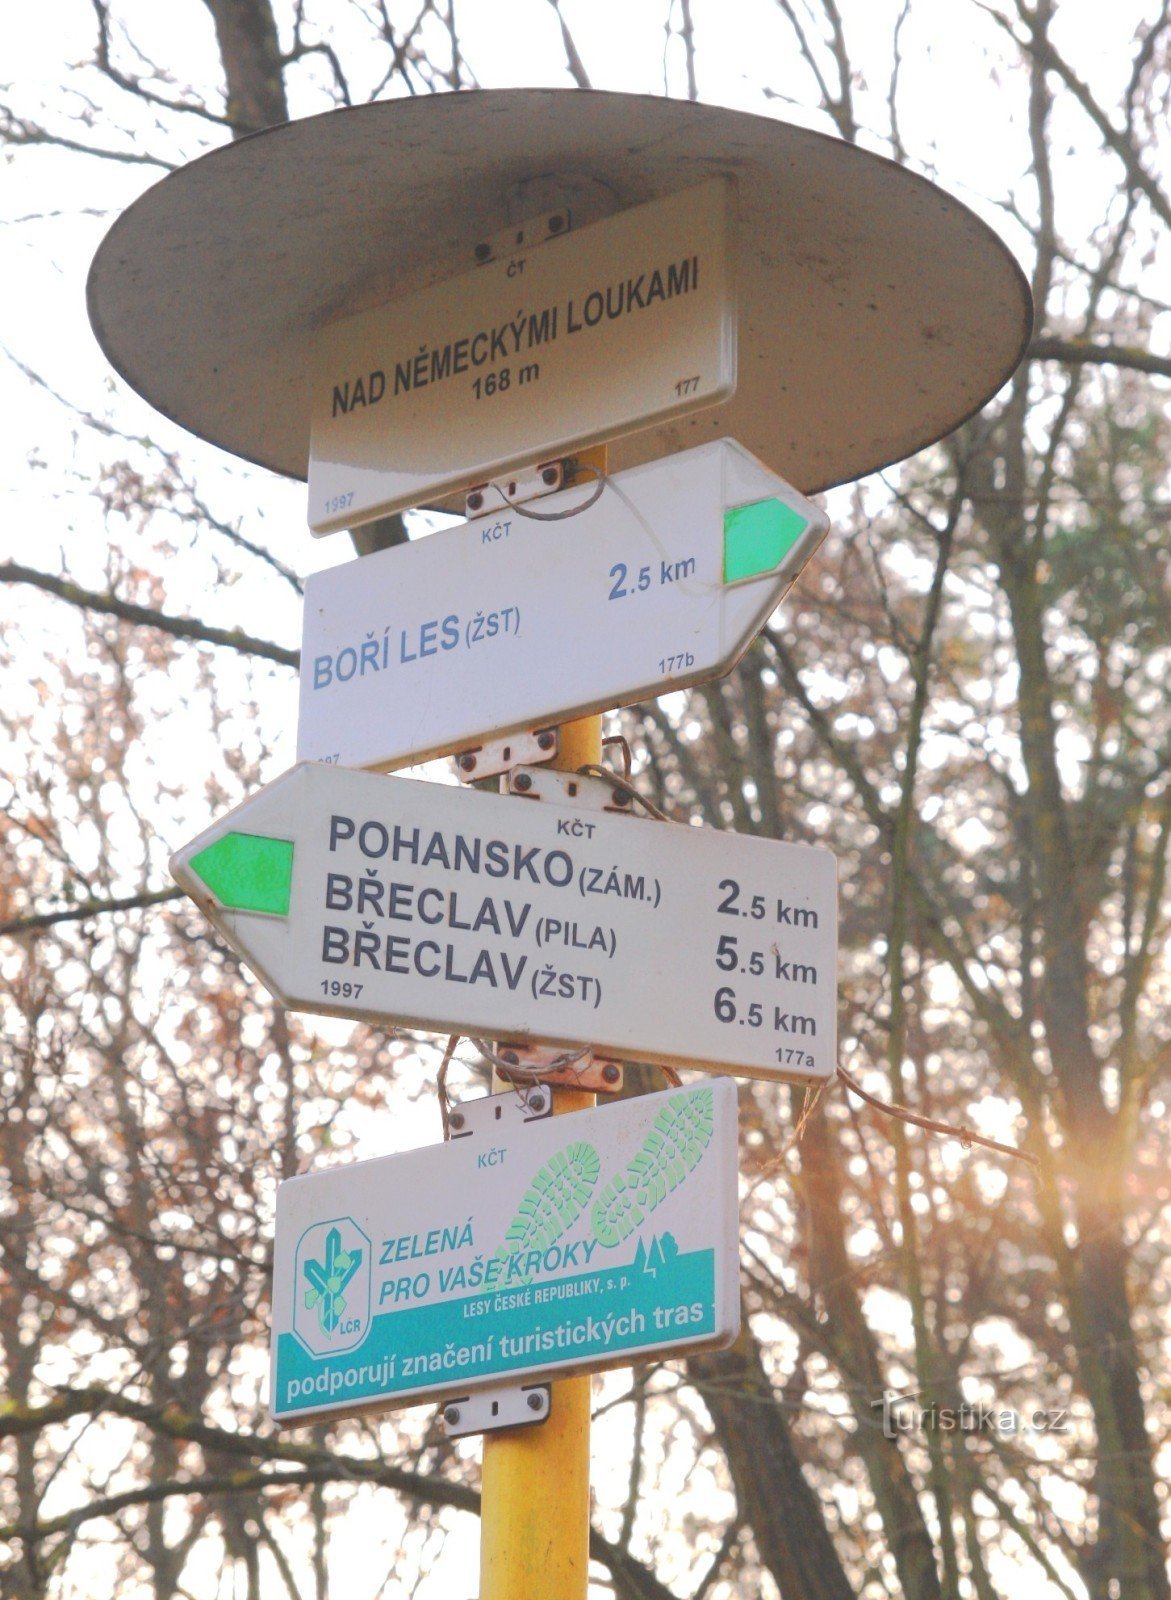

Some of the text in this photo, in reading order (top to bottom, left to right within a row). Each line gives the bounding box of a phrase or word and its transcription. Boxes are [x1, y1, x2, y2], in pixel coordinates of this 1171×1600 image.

[331, 256, 699, 418] NAD NĚMECKÝMI LOUKAMI
[472, 363, 540, 400] 168 m
[674, 376, 700, 397] 177
[324, 492, 355, 514] 1997
[481, 521, 512, 544] KČT
[608, 557, 696, 601] 2.5 km
[313, 627, 390, 689] BOŘÍ
[400, 615, 461, 663] LES
[658, 652, 695, 675] 177b
[557, 819, 597, 839] KČT
[329, 815, 662, 908] POHANSKO (ZÁM.)
[325, 869, 617, 957] BŘECLAV (PILA)
[717, 879, 819, 929] 2.5 km
[321, 921, 602, 1008] BŘECLAV (ŽST)
[715, 935, 818, 984] 5.5 km
[320, 980, 364, 1000] 1997
[713, 987, 817, 1036] 6.5 km
[776, 1047, 815, 1068] 177a
[477, 1149, 508, 1169] KČT
[378, 1217, 474, 1266] ZELENÁ
[378, 1239, 598, 1306] PRO VAŠE KROKY
[464, 1300, 490, 1318] LESY
[494, 1289, 531, 1312] ČESKÉ
[534, 1278, 604, 1304] REPUBLIKY,
[607, 1280, 616, 1290] s.
[287, 1301, 704, 1404] podporují značení turistických tras
